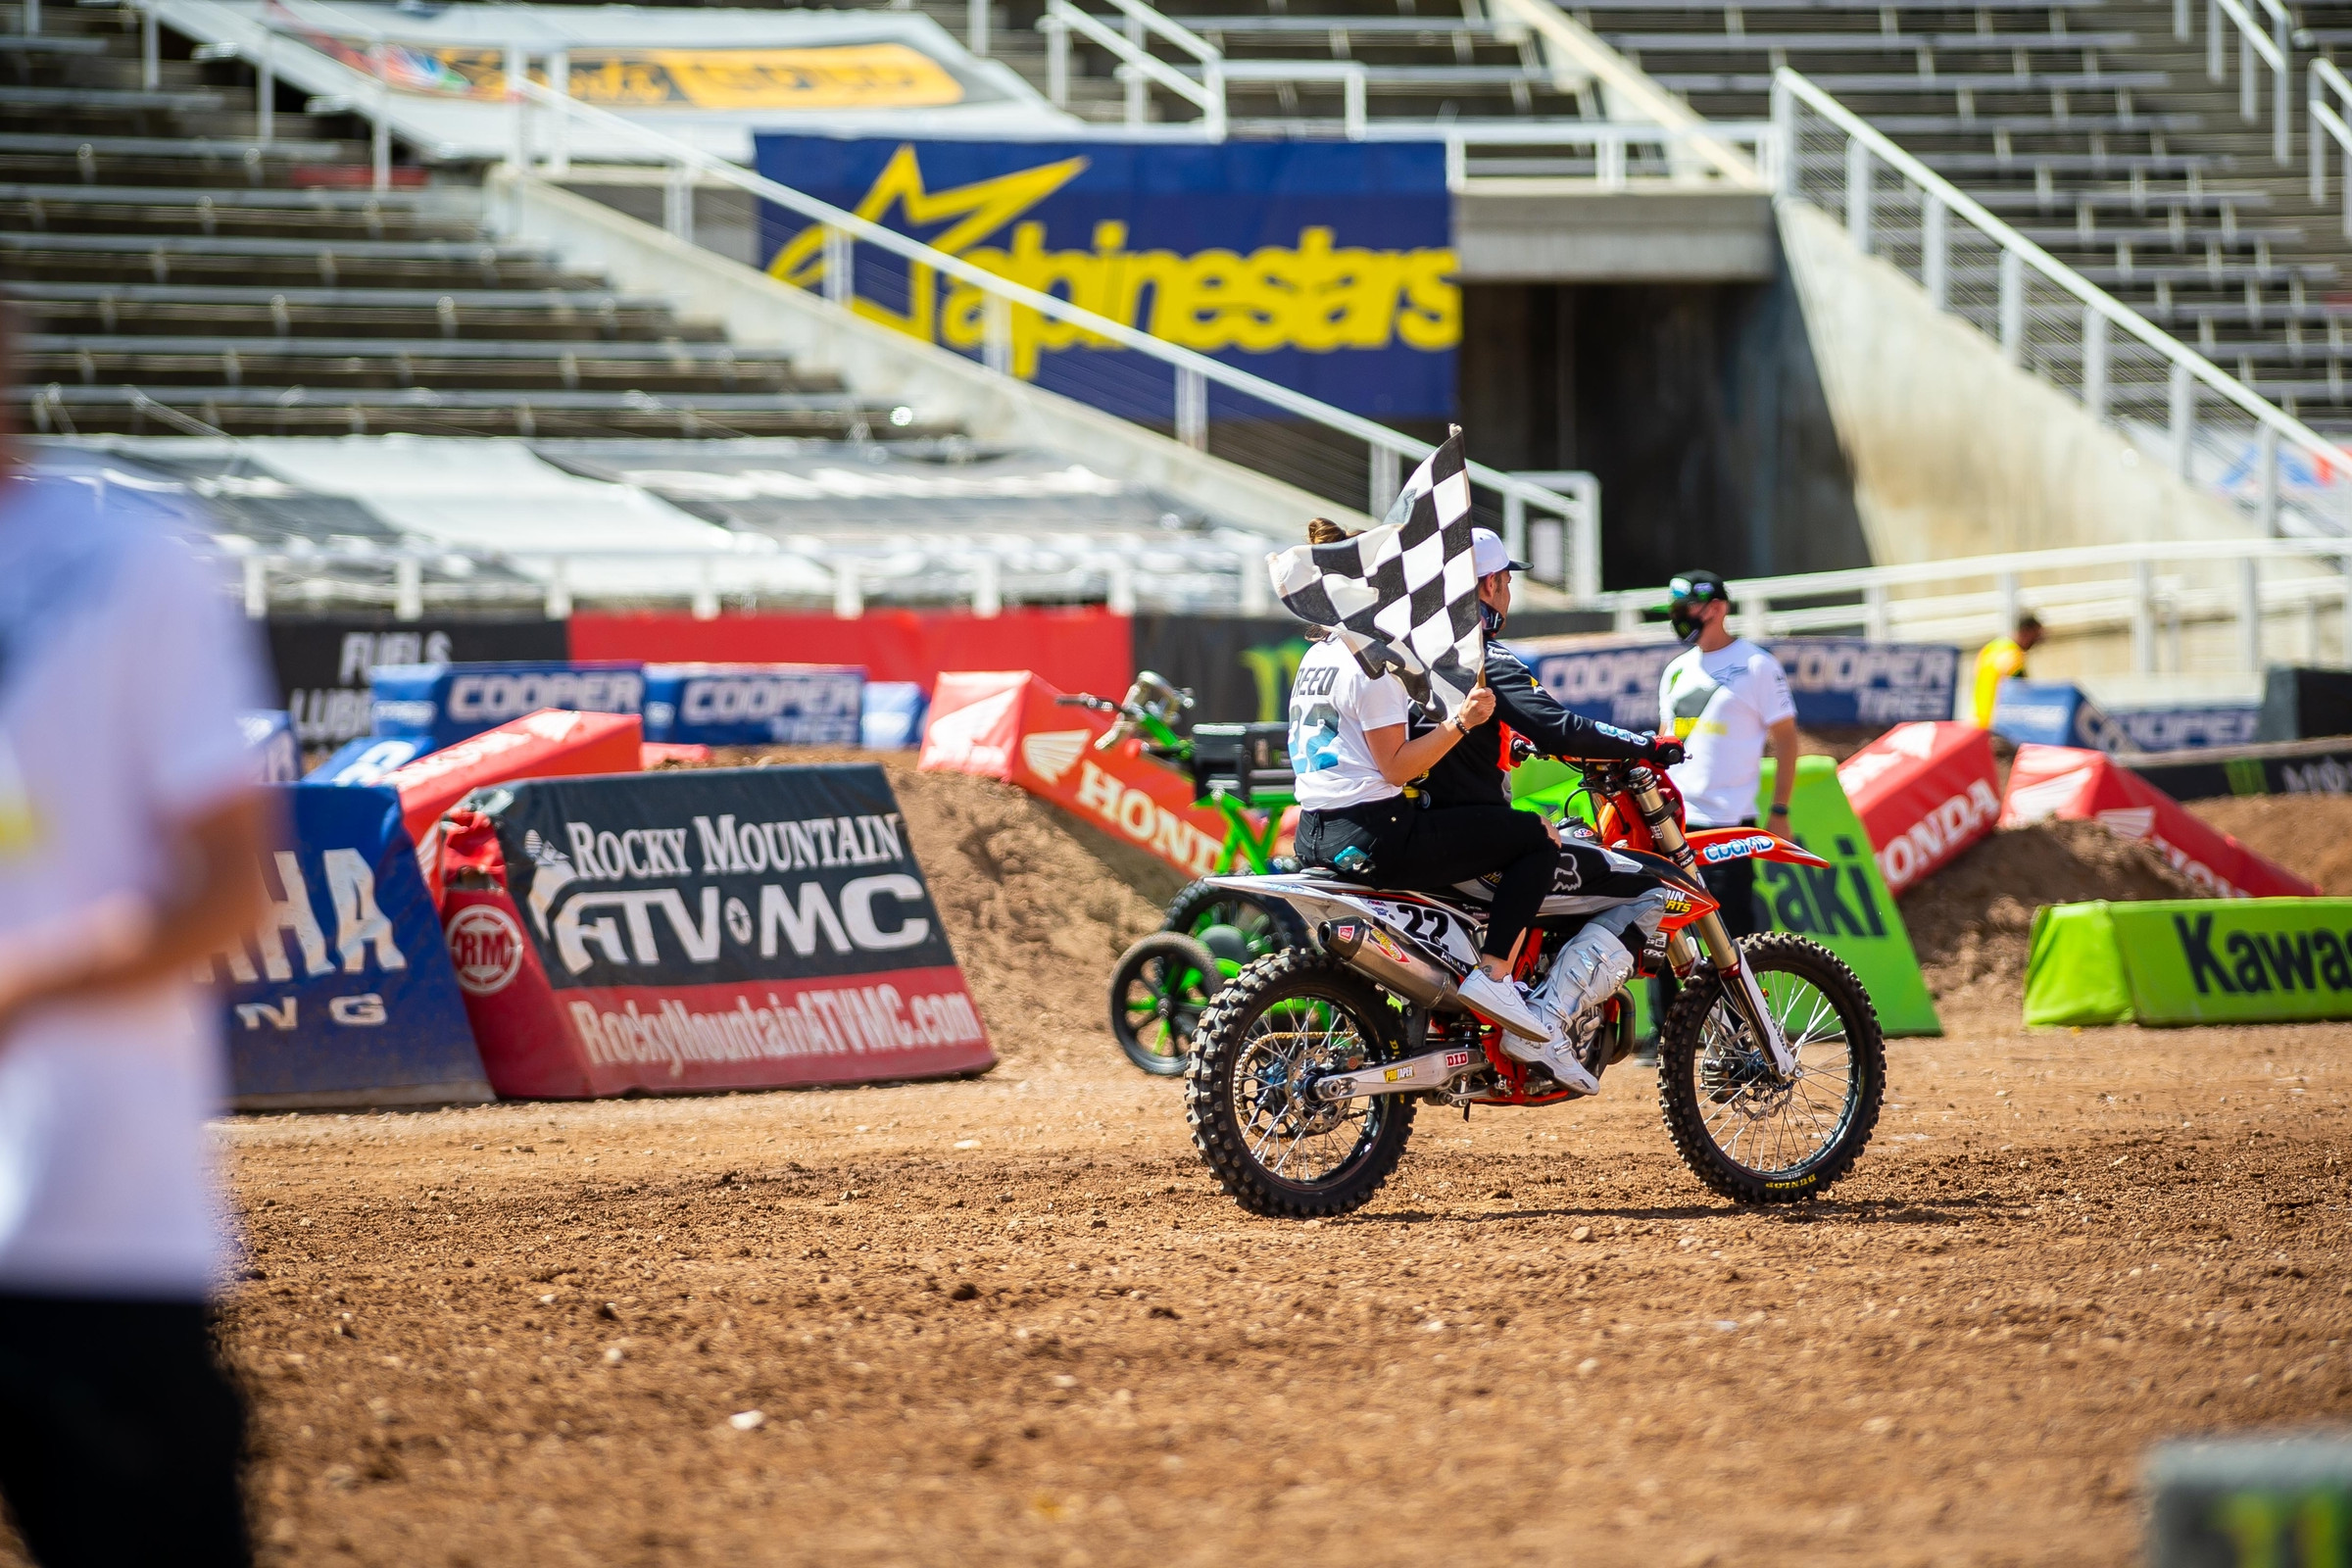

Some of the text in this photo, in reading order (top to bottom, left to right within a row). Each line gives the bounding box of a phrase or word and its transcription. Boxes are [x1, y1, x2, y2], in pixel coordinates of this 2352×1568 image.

[448, 672, 644, 727] COOPER
[566, 812, 904, 881] ROCKY MOUNTAIN
[1396, 904, 1449, 953] 22
[2171, 908, 2352, 998] Kawa
[1446, 1053, 1468, 1067] DID
[1765, 1173, 1817, 1189] DUNLOP
